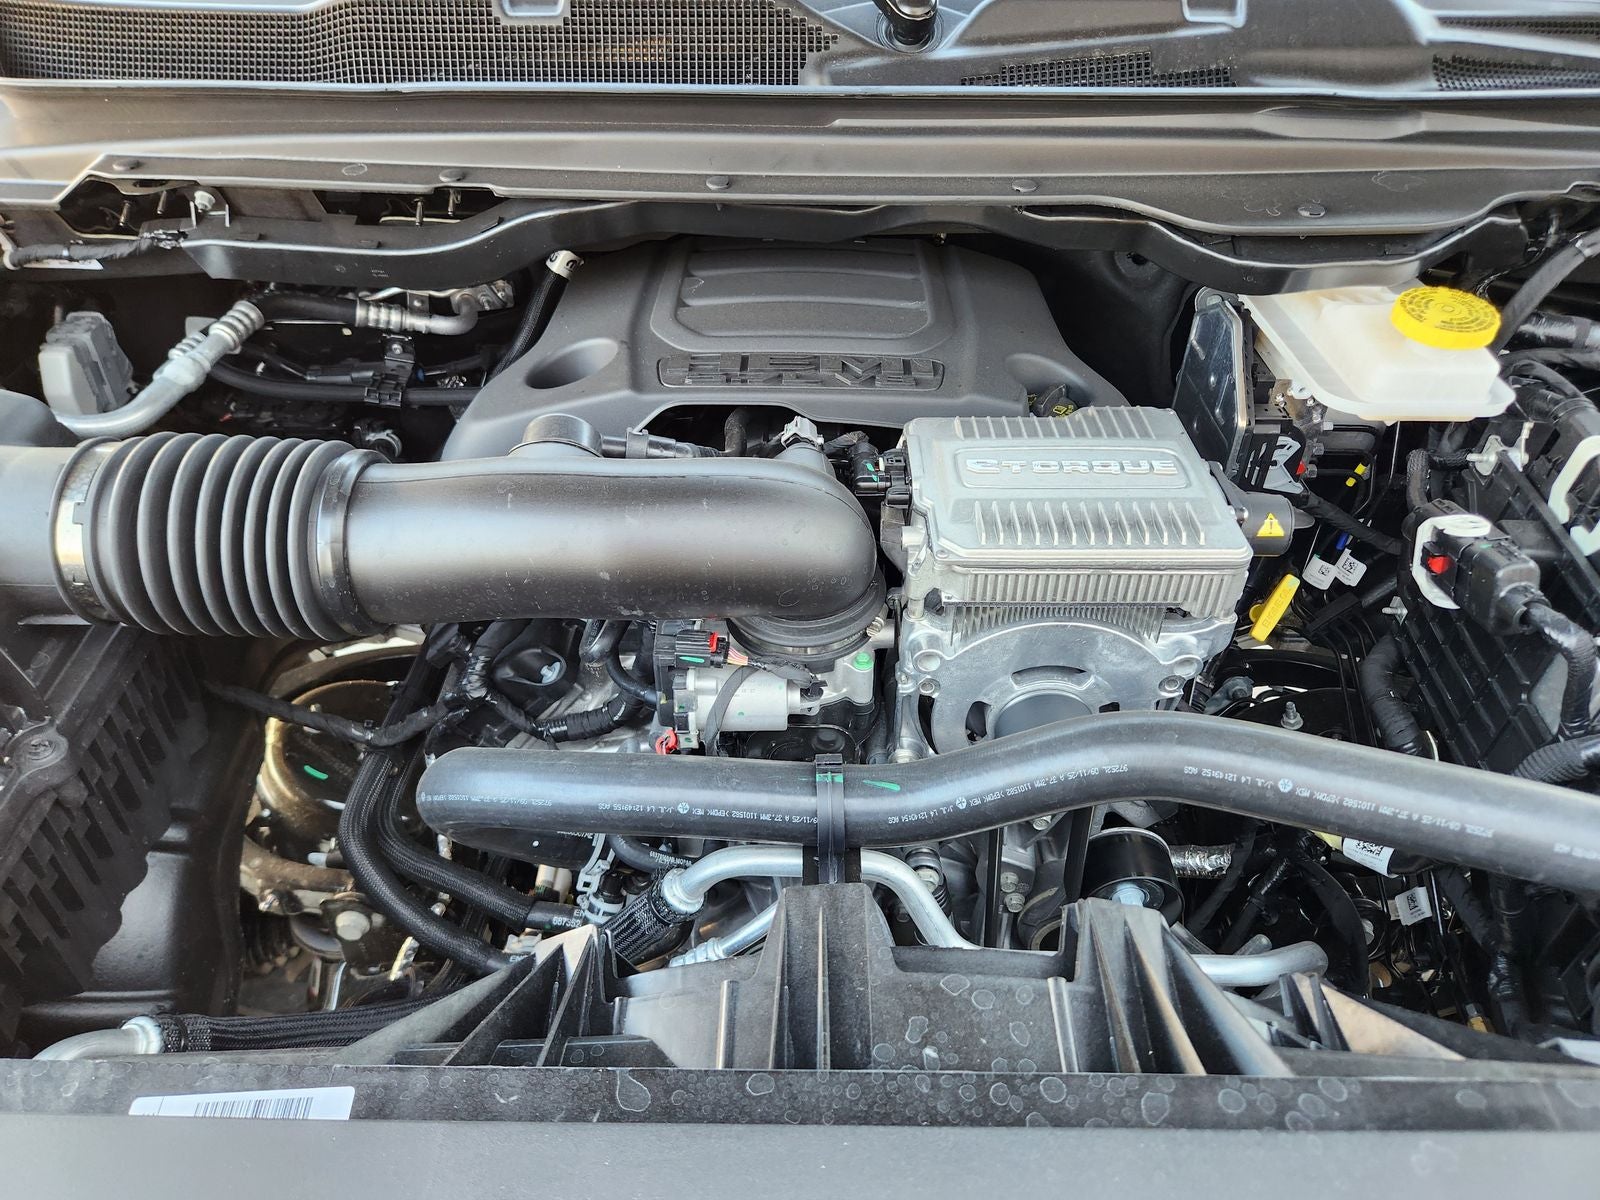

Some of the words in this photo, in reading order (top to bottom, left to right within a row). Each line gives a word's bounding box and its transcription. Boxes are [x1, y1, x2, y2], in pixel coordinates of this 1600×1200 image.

[598, 802, 611, 810] AGS
[692, 807, 705, 816] MEX
[792, 814, 819, 824] 9/11/25
